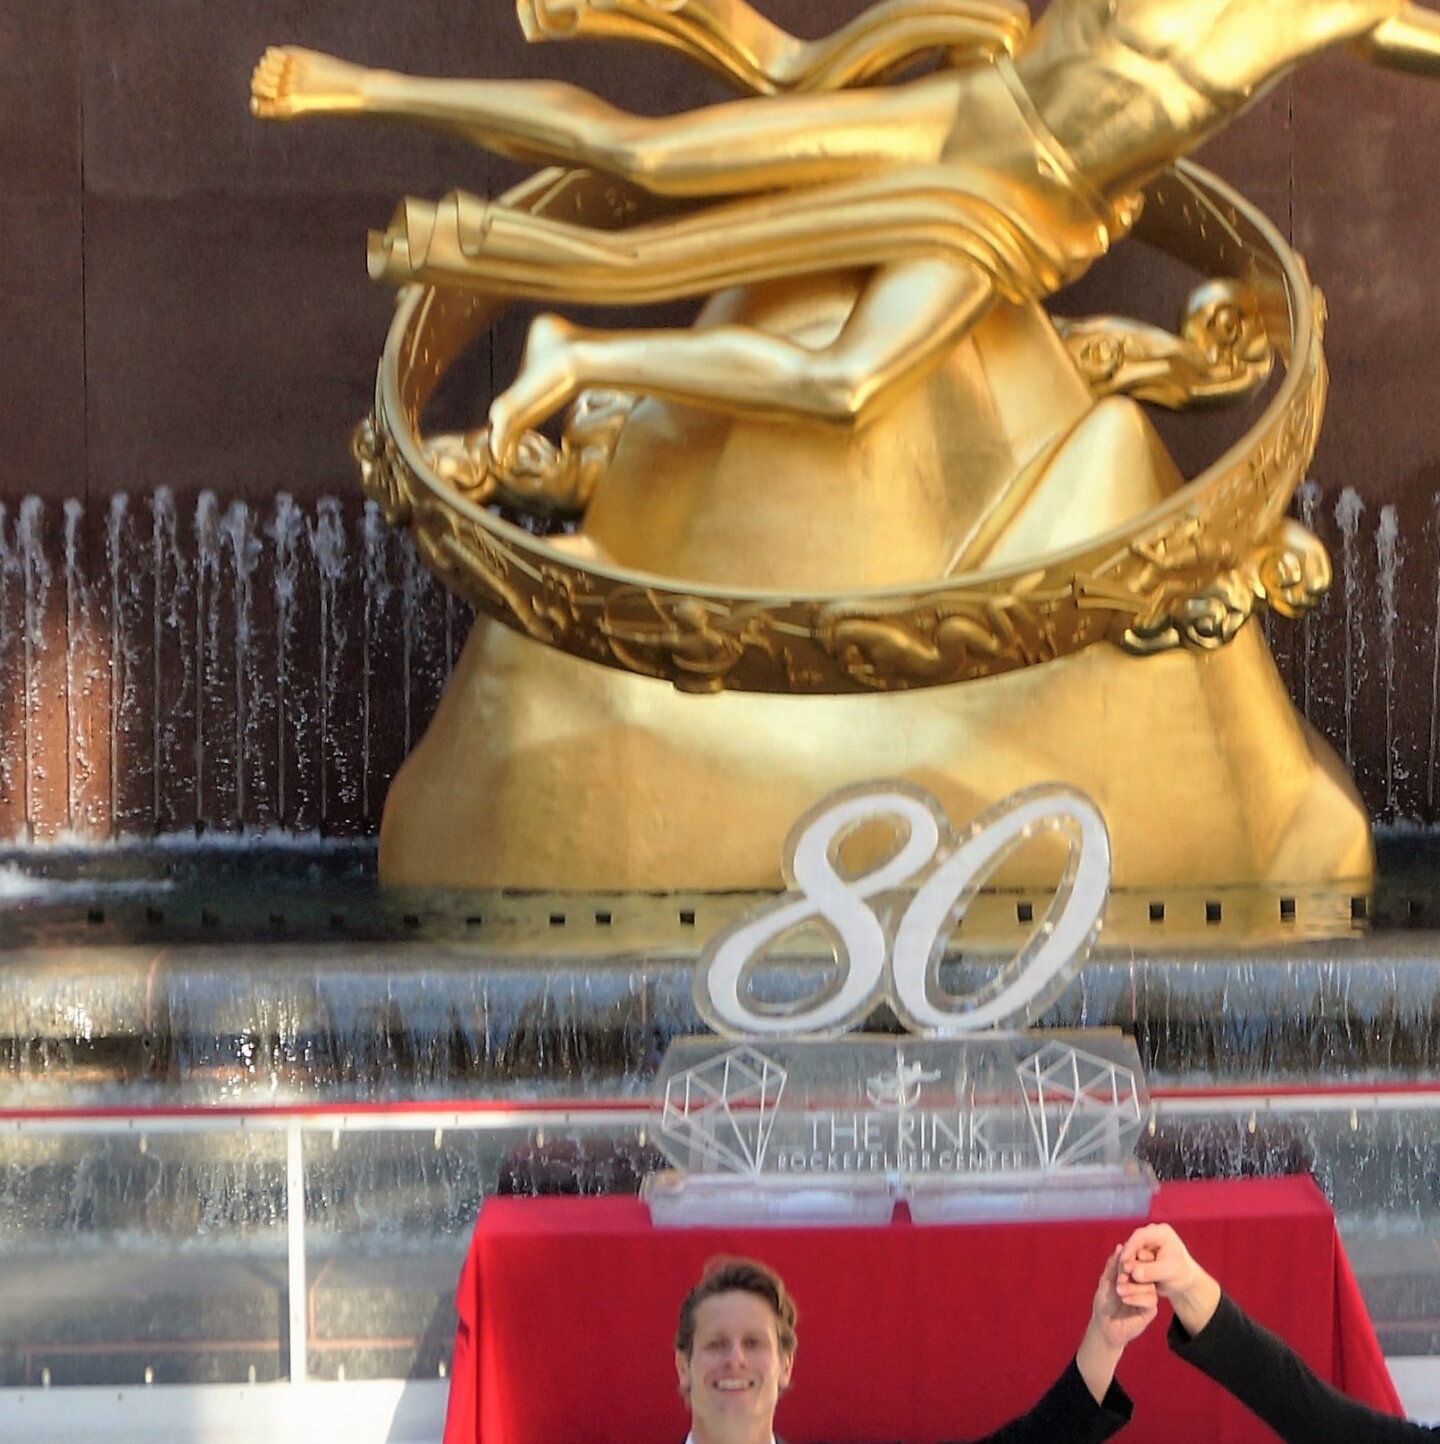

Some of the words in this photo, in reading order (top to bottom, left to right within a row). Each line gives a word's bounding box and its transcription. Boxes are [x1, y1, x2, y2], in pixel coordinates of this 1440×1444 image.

[706, 790, 1110, 1035] 80
[804, 1109, 883, 1152] THE
[896, 1108, 991, 1153] RINK
[938, 1150, 1022, 1173] CENTER
